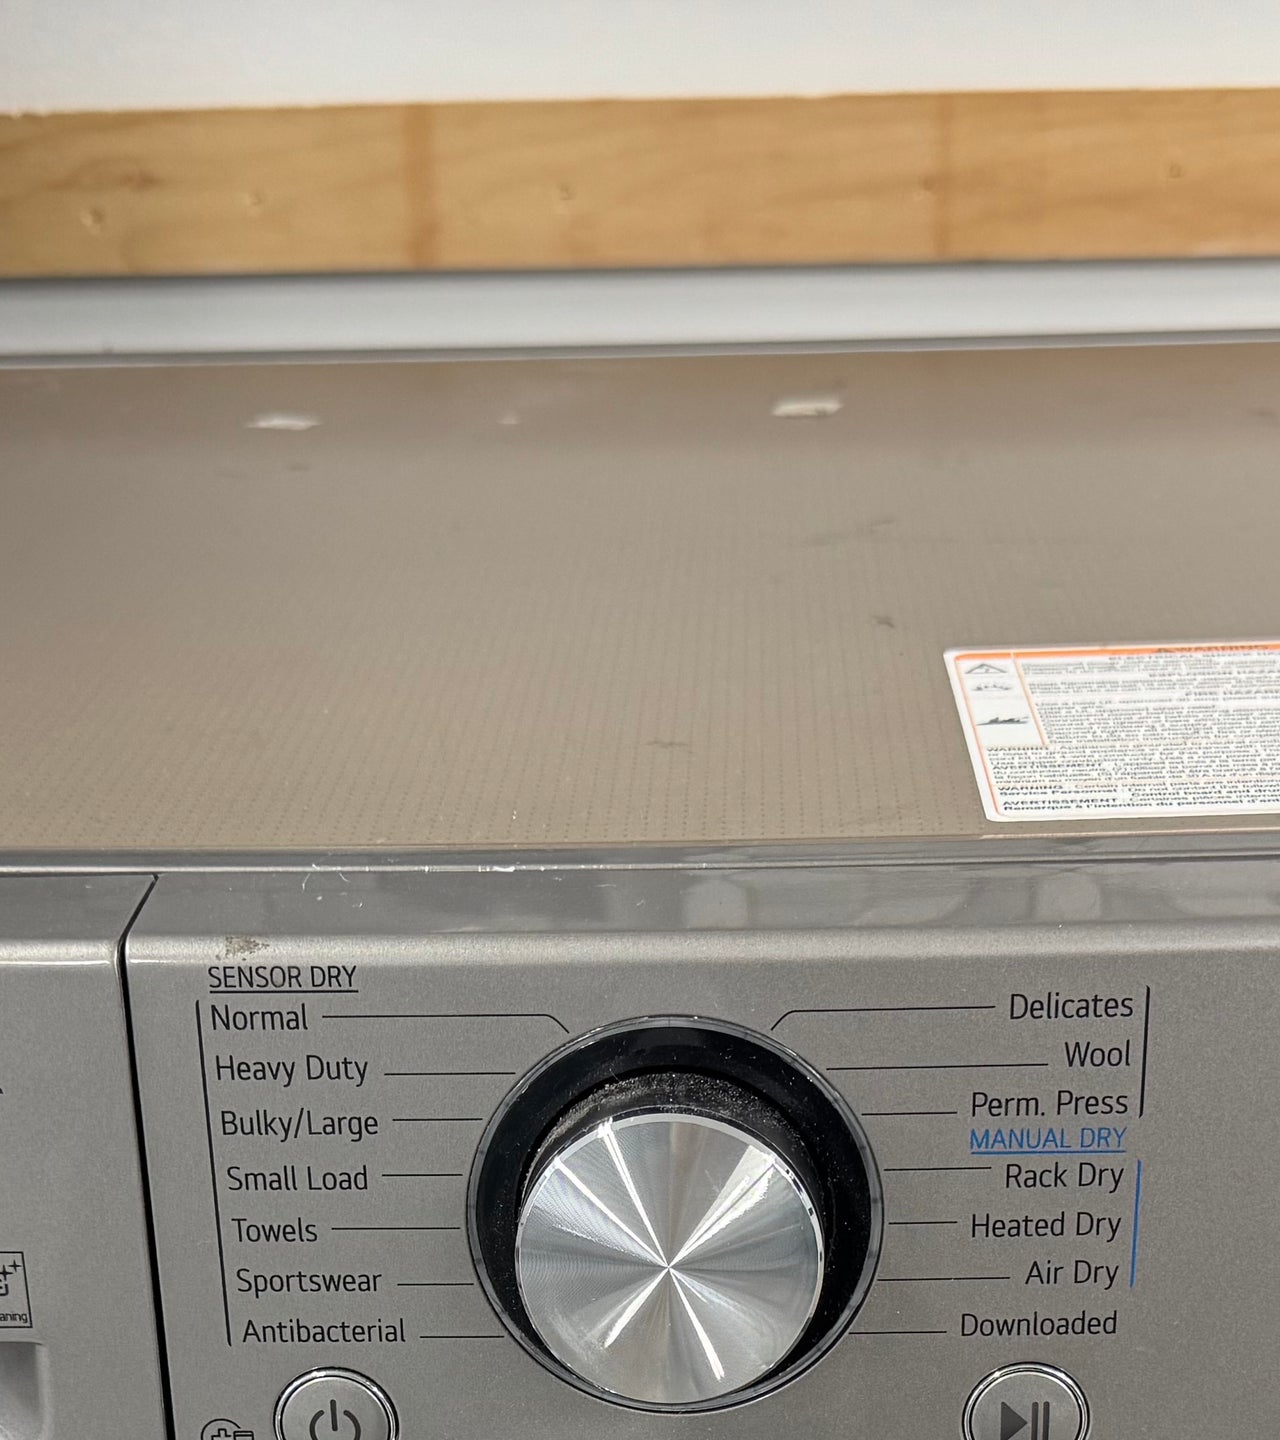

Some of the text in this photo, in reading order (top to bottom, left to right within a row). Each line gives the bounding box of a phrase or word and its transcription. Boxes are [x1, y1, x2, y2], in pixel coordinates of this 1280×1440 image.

[208, 966, 356, 988] SENSOR DRY
[211, 1003, 308, 1031] Normal
[1010, 992, 1133, 1020] Delicates
[1065, 1039, 1131, 1067] Wool
[216, 1054, 368, 1087] Heavy Duty
[971, 1090, 1128, 1117] Perm. Press
[221, 1107, 378, 1141] Bulky/Large
[970, 1127, 1127, 1149] MANUAL DRY
[227, 1165, 368, 1191] Small Load
[1006, 1161, 1124, 1194] Rack Dry
[232, 1217, 318, 1242] Towels
[971, 1211, 1121, 1242] Heated Dry
[236, 1268, 382, 1298] Sportswear
[1025, 1260, 1119, 1290] Air Dry
[243, 1318, 406, 1342] Antibacterial
[960, 1311, 1117, 1337] Downloaded
